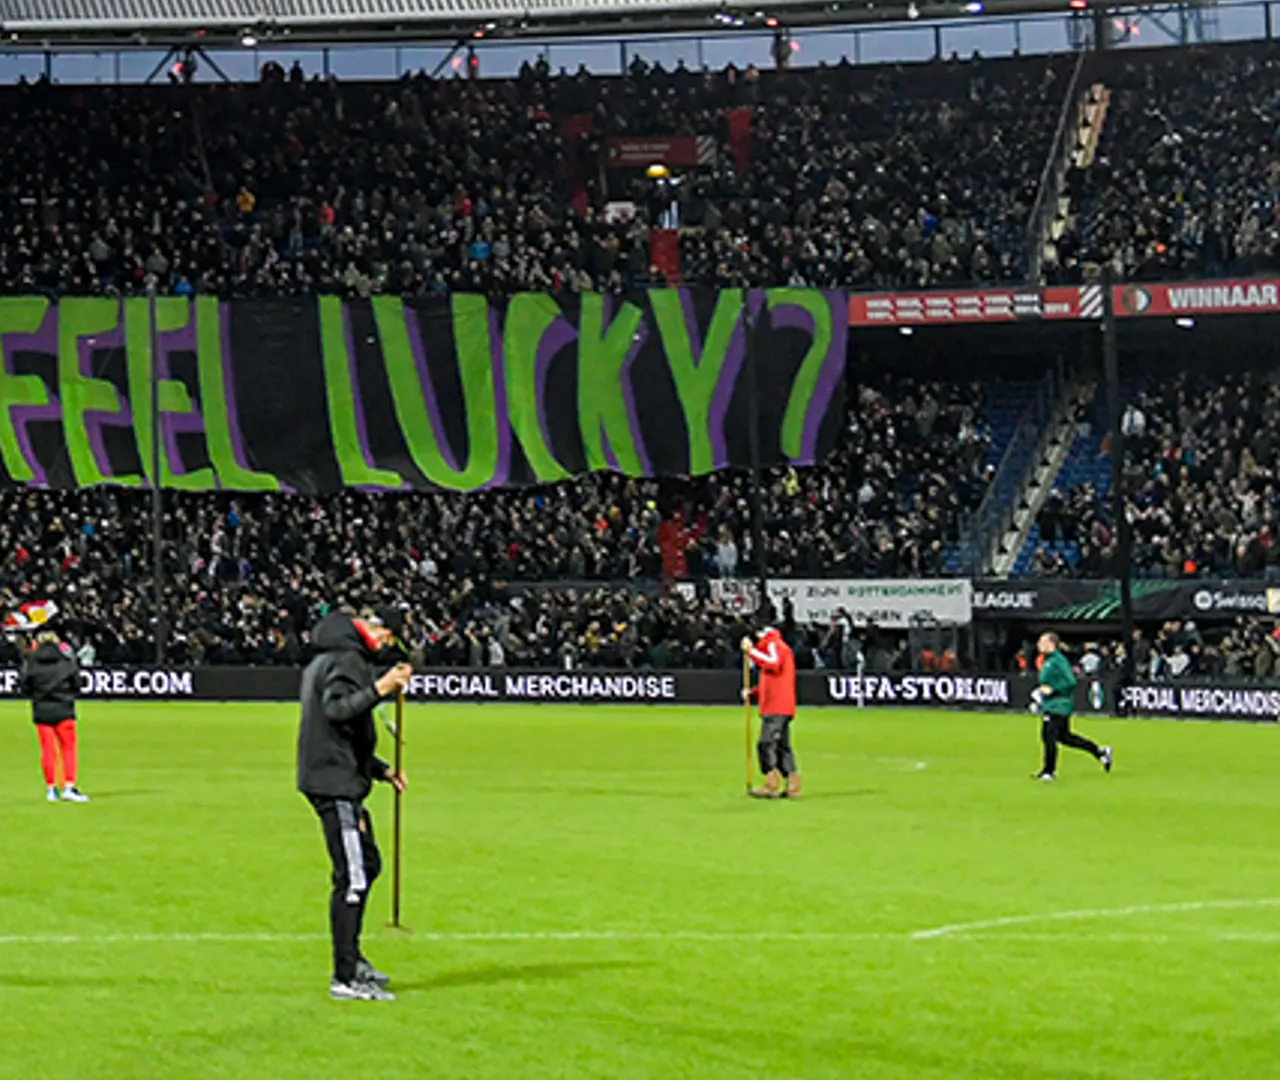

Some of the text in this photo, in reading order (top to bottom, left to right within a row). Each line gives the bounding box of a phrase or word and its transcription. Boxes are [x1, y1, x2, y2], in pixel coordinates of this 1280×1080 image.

[1168, 284, 1278, 309] WINNAAR
[318, 287, 848, 492] LUCKY?
[505, 676, 675, 697] MERCHANDISE
[828, 677, 1008, 702] UEFA-STORE.COM
